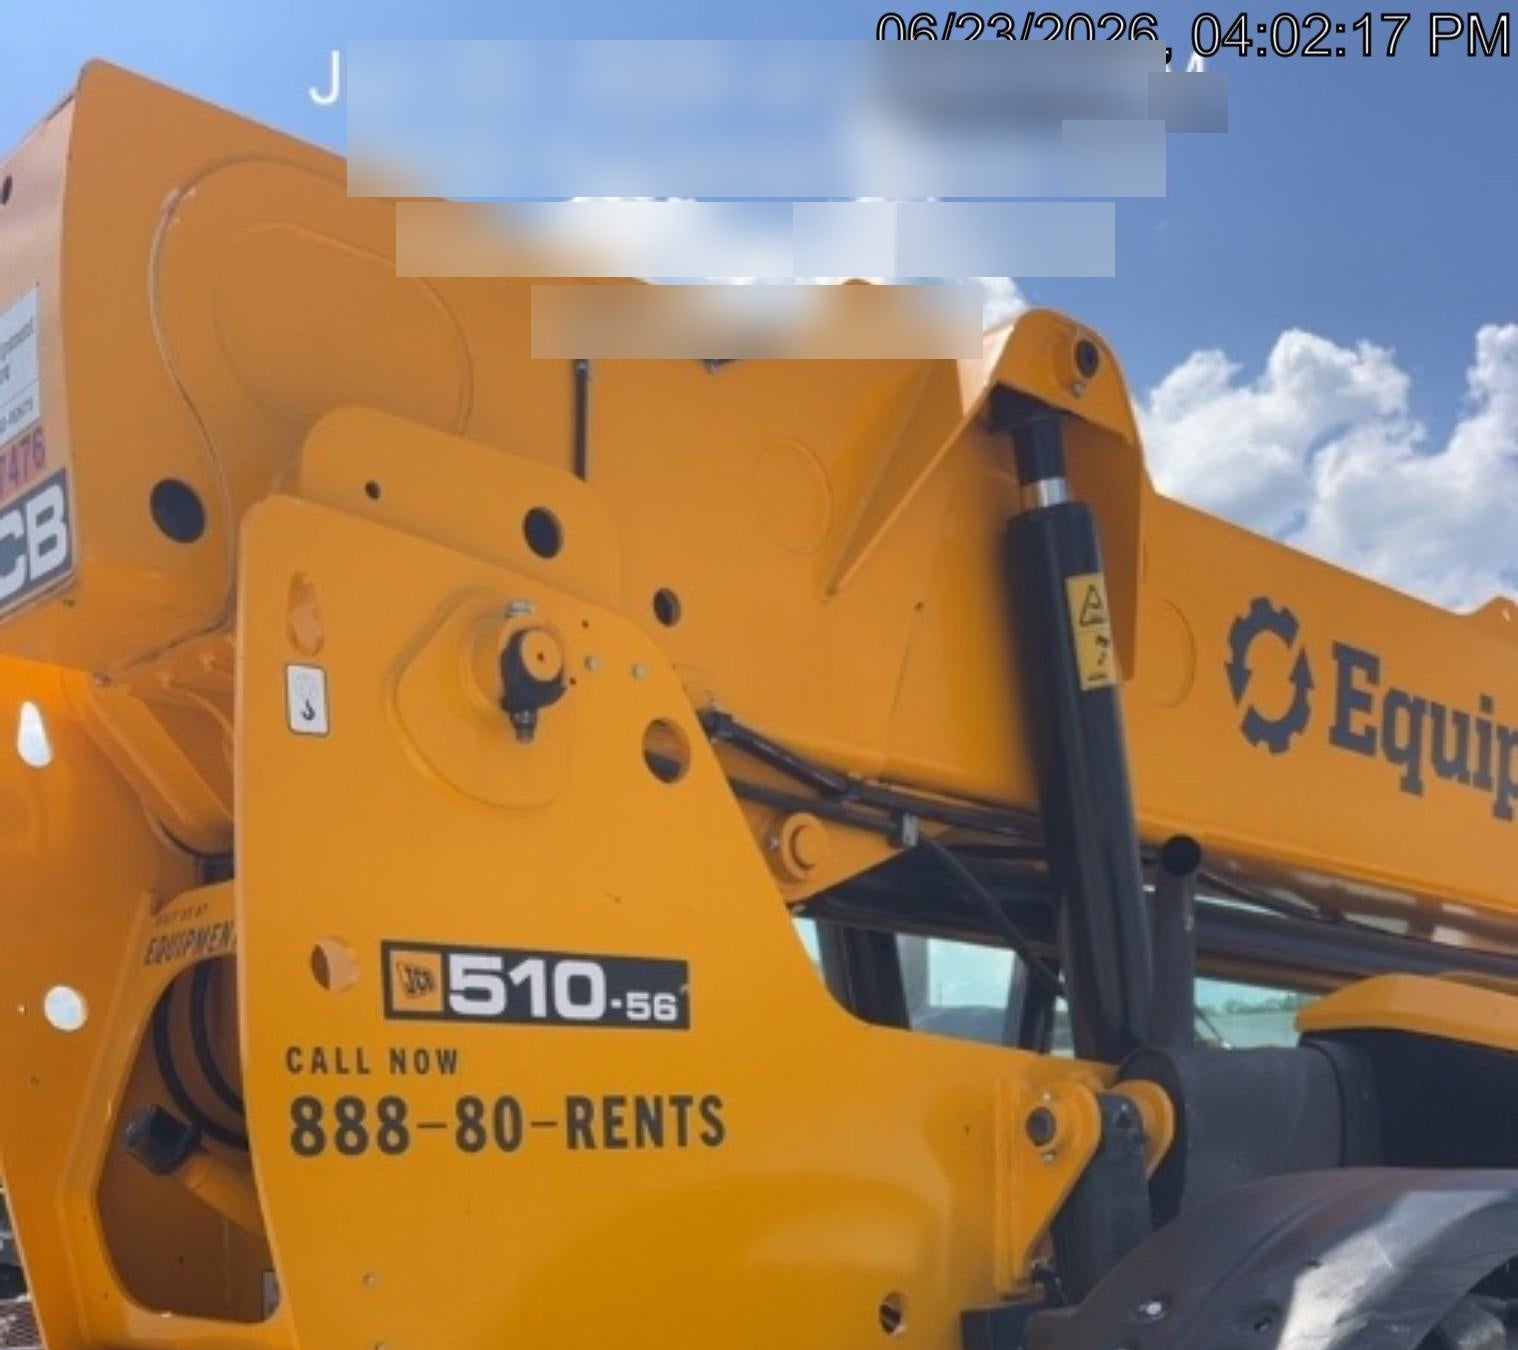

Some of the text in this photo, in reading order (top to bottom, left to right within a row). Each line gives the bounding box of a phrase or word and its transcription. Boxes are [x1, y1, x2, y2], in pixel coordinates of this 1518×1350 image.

[286, 1046, 458, 1075] CALL NOW
[290, 1094, 726, 1157] 888-80-RENTS
